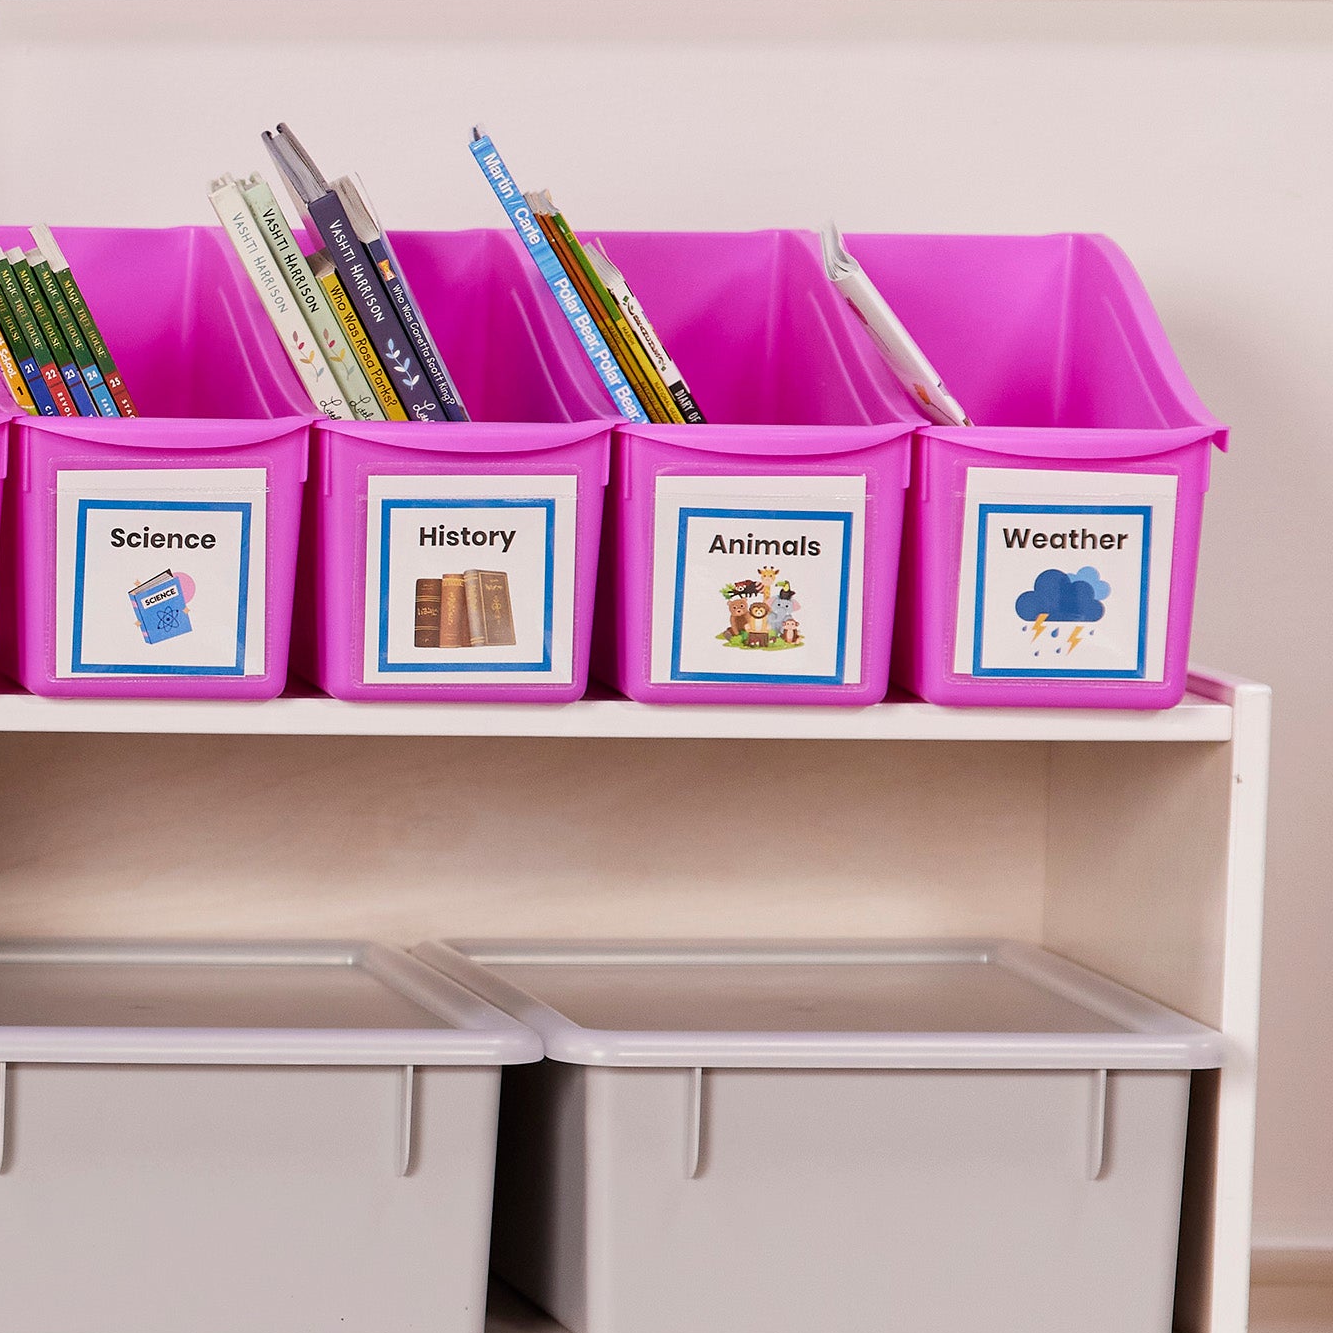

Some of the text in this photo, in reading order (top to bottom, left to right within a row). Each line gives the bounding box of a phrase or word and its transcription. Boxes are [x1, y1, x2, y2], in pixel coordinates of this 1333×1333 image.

[483, 152, 514, 199] Martin
[514, 207, 541, 246] Carle
[233, 211, 289, 313] VASHTI HARRISON
[262, 208, 320, 313] VASHTI HARRISON
[329, 219, 385, 323] VASHTI HARRISON
[392, 284, 456, 405] Who Was Coretta Scott King?
[553, 277, 583, 323] Polar
[574, 311, 600, 351] Bear,
[594, 349, 622, 386] Polar
[330, 284, 398, 407] Who Was Rosa Parks?
[24, 363, 35, 374] 21
[45, 369, 57, 380] 22
[64, 369, 76, 380] 23
[86, 370, 98, 381] 24
[16, 386, 24, 396] 1
[109, 377, 121, 389] 25
[674, 388, 702, 423] DIARY OF
[110, 526, 216, 549] Science
[419, 525, 517, 553] History
[708, 534, 821, 557] Animals
[1003, 525, 1129, 551] Weather
[144, 588, 176, 606] SCIENCE
